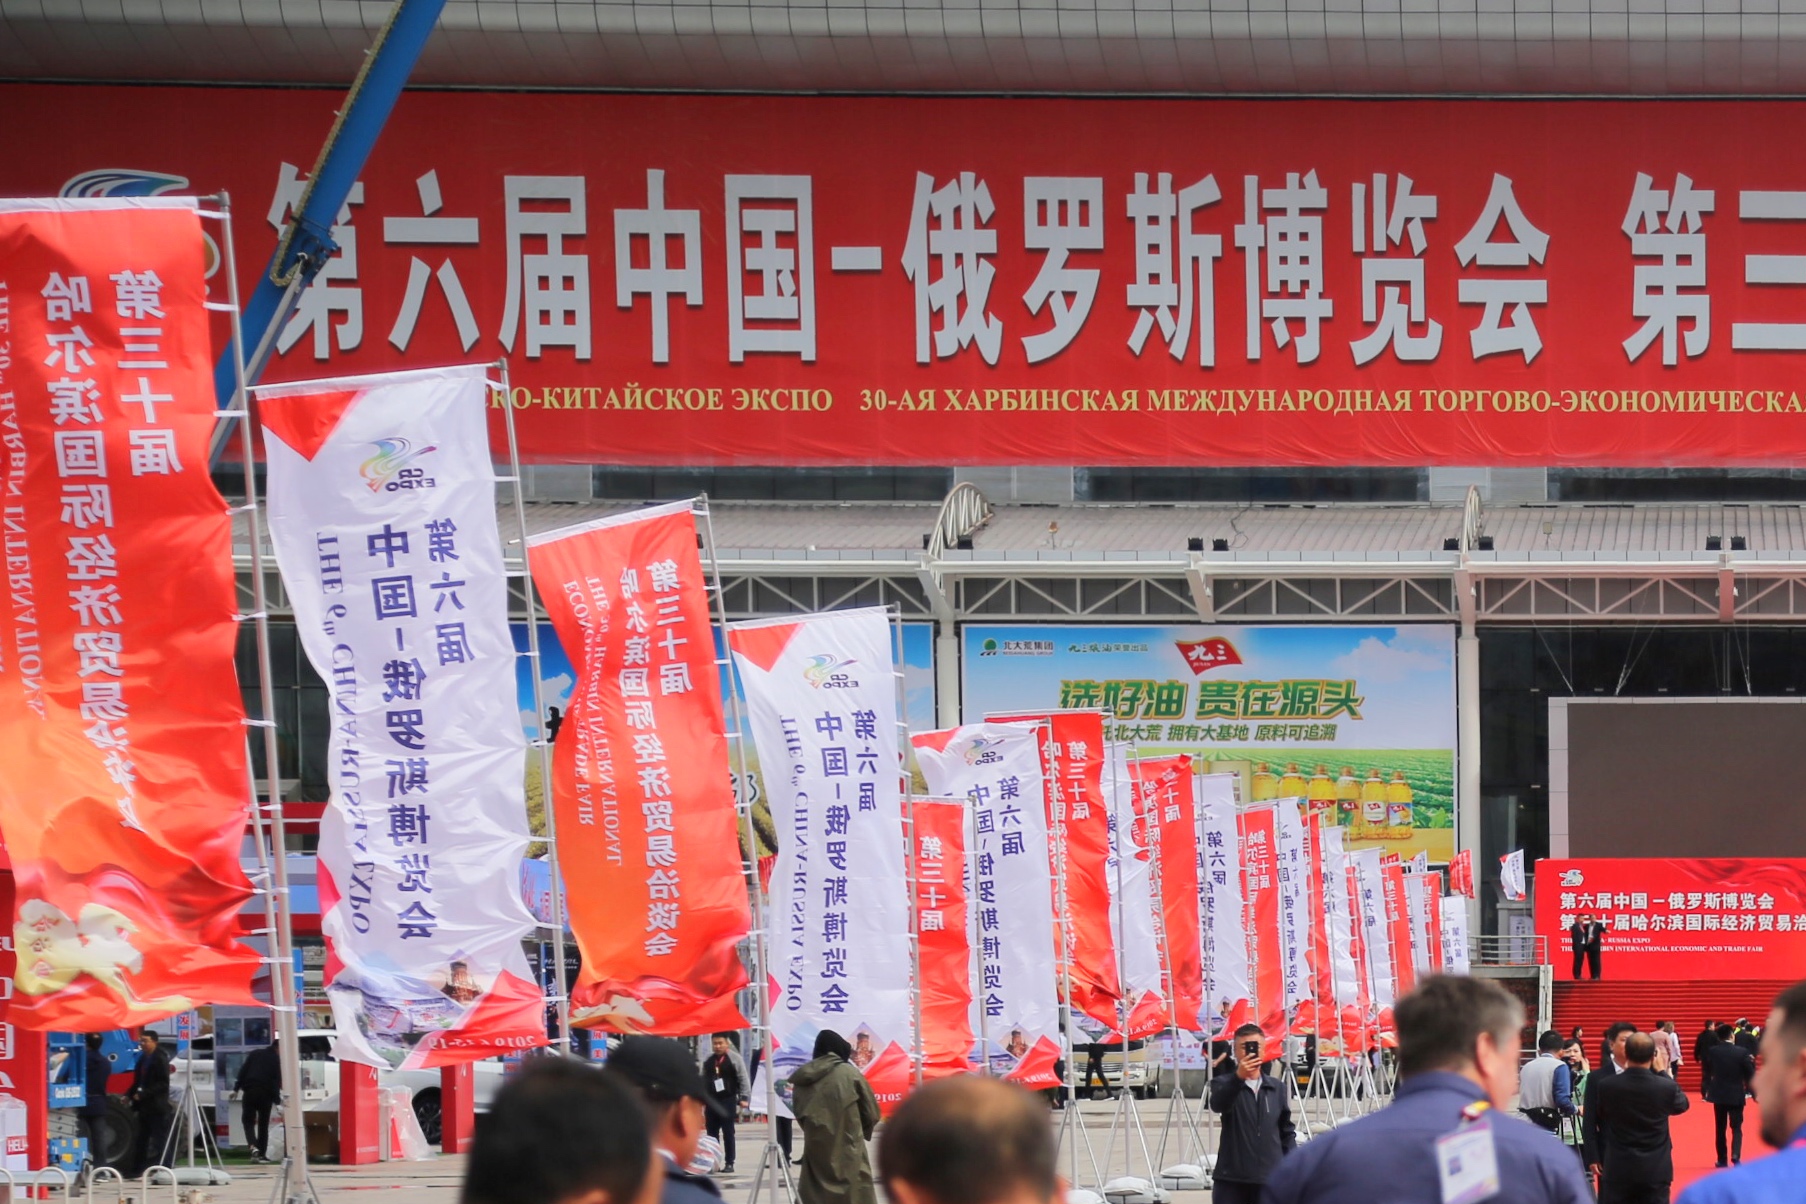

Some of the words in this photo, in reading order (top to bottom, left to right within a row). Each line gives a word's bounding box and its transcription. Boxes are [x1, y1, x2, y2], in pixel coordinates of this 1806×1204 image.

[485, 382, 724, 411] КО-КИТАЙСКОЕ
[731, 388, 833, 411] ЭКСПО
[860, 388, 937, 411] 30-АЯ
[943, 388, 1139, 411] ХАРБИНСКАЯ
[1147, 388, 1418, 416] МЕЖДУНАРОДНАЯ
[1003, 641, 1054, 651] 北大荒集团
[1060, 679, 1190, 721] 选好油
[1195, 679, 1367, 721] 贵在源头
[1167, 724, 1249, 742] 拥有大基地
[1254, 723, 1337, 742] 原料可追溯
